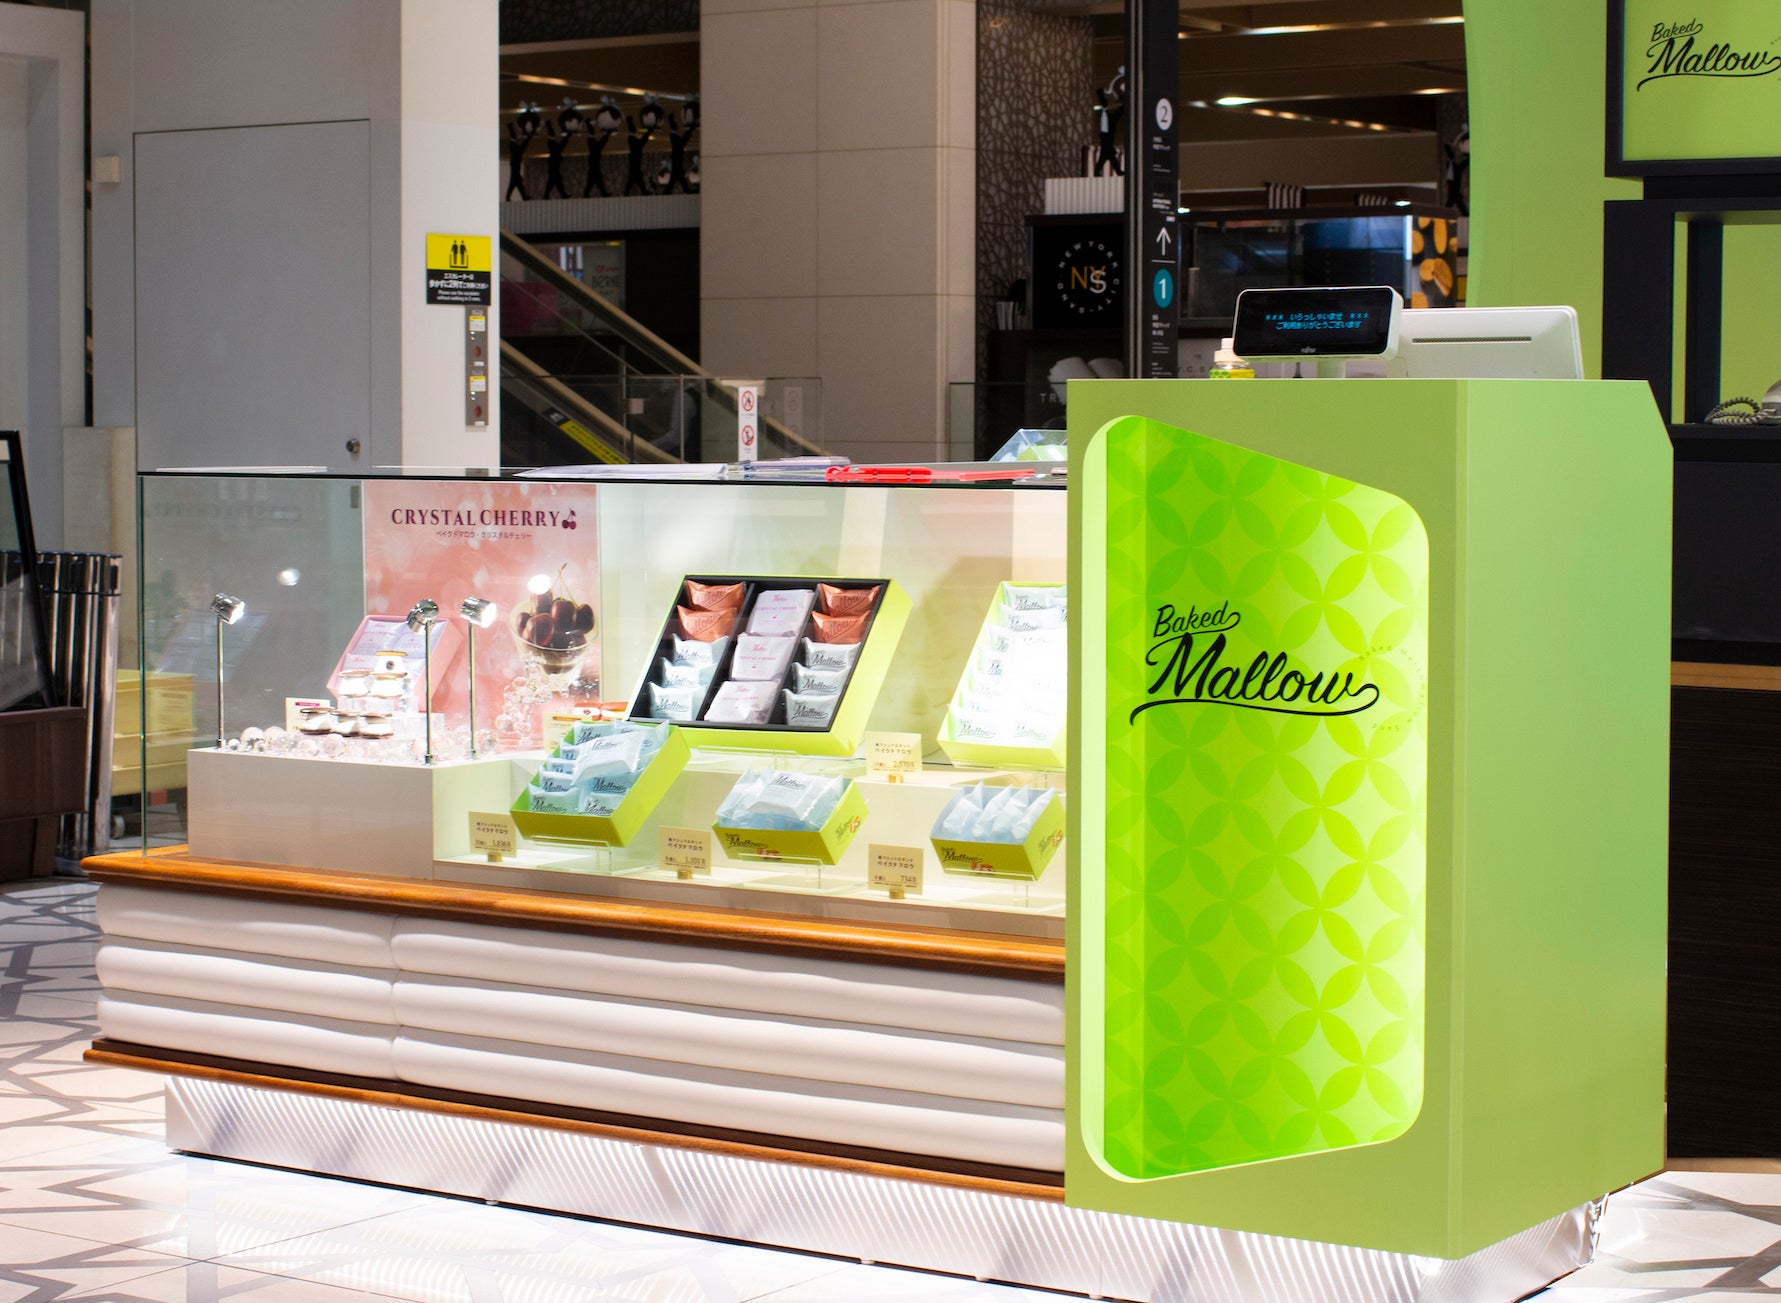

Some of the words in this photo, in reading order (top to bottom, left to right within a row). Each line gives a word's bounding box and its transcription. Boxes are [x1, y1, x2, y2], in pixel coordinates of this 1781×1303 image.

[1650, 18, 1703, 42] Baked
[1639, 36, 1781, 86] Mallow
[1160, 105, 1168, 123] 2
[1158, 277, 1166, 300] 1
[391, 508, 476, 526] CRYSTAL
[480, 509, 560, 527] CHERRY
[1153, 600, 1241, 638] Baked
[1138, 633, 1379, 717] Mallow
